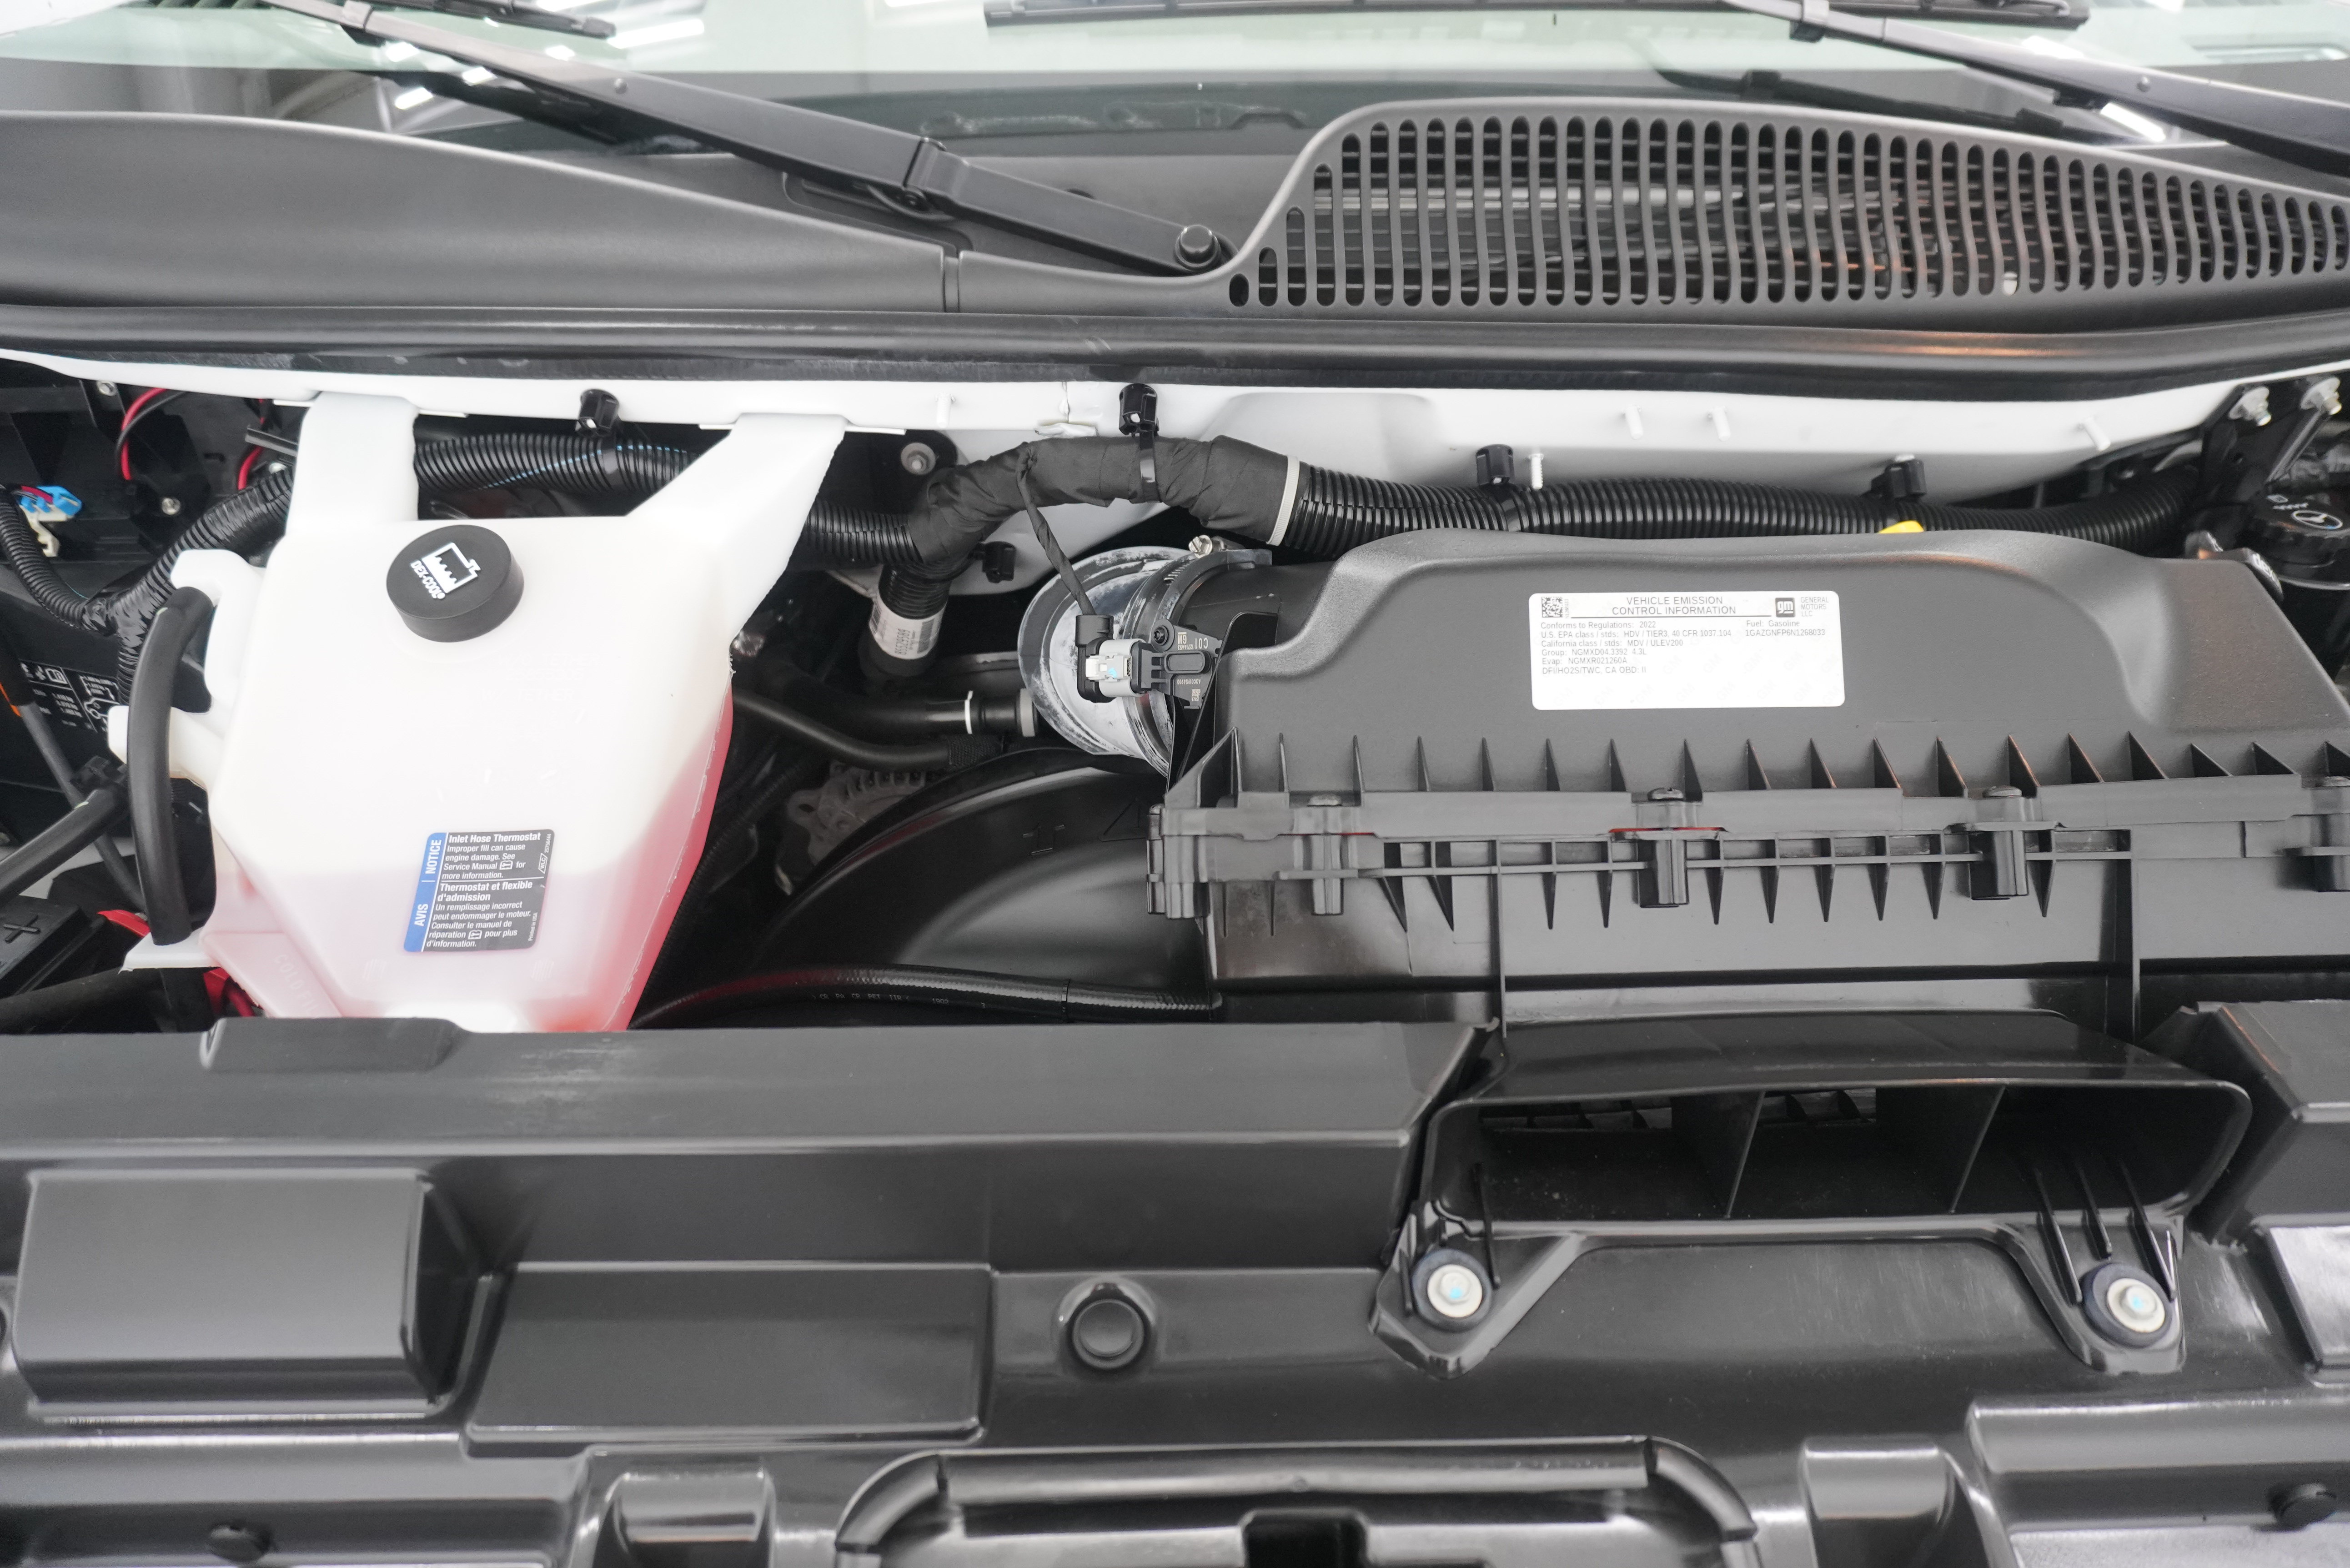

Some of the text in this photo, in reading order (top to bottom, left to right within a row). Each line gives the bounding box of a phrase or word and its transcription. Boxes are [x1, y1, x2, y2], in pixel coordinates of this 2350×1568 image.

[1627, 596, 1723, 605] VEHICLE EMISSION
[1612, 606, 1737, 615] CONTROL INFORMATION
[1588, 621, 1633, 630] Regulations:
[1177, 634, 1187, 644] GM
[1195, 637, 1209, 649] C01
[449, 832, 541, 843] Inlet Hose Thermostat
[447, 845, 480, 854] Improper
[425, 839, 442, 874] NOTICE
[445, 854, 470, 862] engine
[471, 854, 500, 862] damage.
[472, 862, 497, 870] Manual
[462, 871, 504, 879] information.
[439, 880, 533, 892] Thermostat et flexible
[437, 892, 491, 902] d'admission
[446, 902, 490, 912] remplissage
[492, 901, 522, 910] incorrect
[414, 904, 428, 926] AVIS
[451, 911, 497, 920] endommager
[429, 929, 518, 939] réparation pour plus
